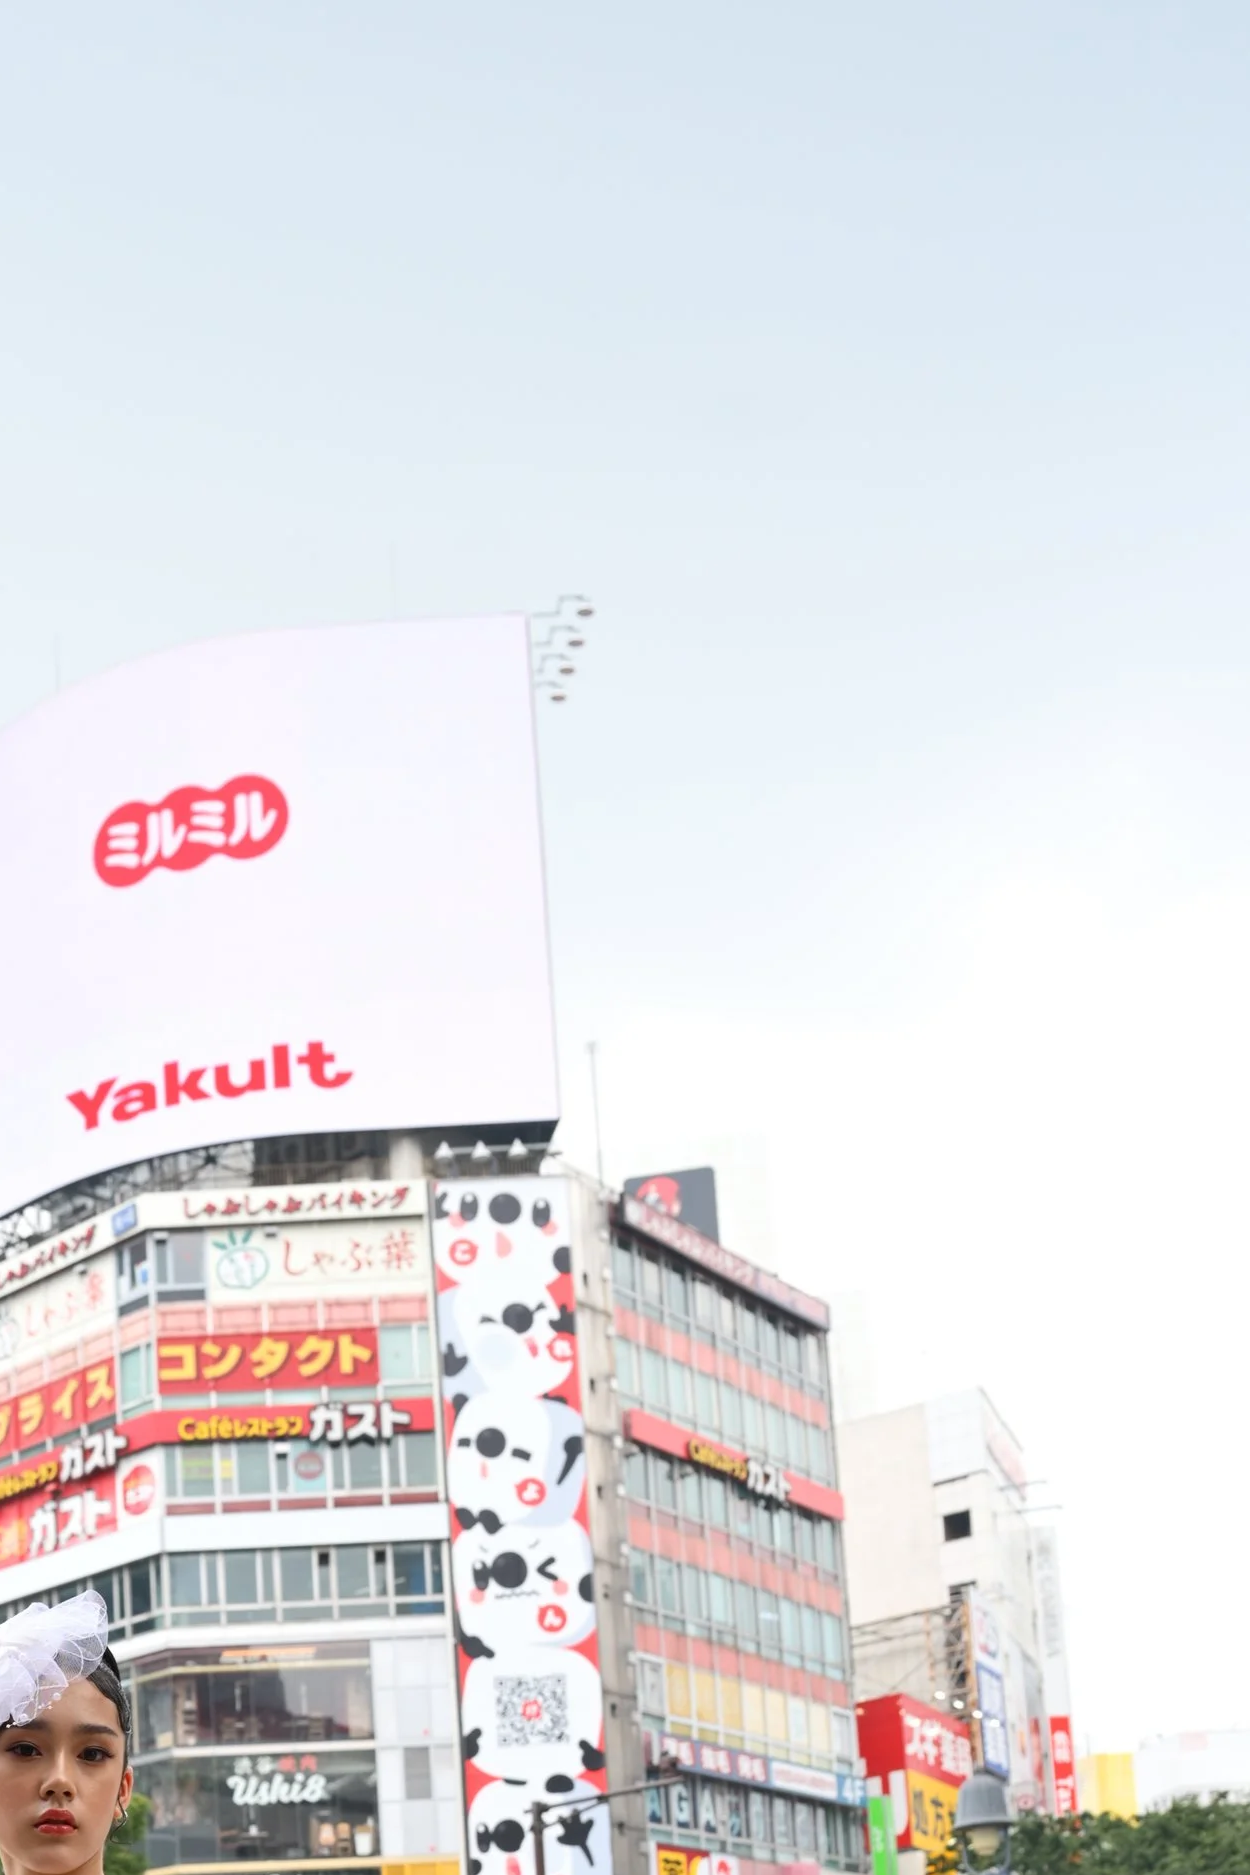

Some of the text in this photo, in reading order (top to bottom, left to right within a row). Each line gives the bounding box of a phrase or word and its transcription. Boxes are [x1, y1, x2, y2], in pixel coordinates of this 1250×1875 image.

[105, 791, 277, 868] ミルミル
[66, 1040, 354, 1131] Yakult
[184, 1187, 410, 1217] しゃぶしゃぶバイキング
[283, 1229, 414, 1276] しゃぶ葉
[159, 1334, 372, 1380] コンタクト
[309, 1401, 411, 1443] ガスト
[60, 1428, 126, 1482] ガスト
[29, 1489, 111, 1557] ガスト
[226, 1773, 329, 1806] Ushi8
